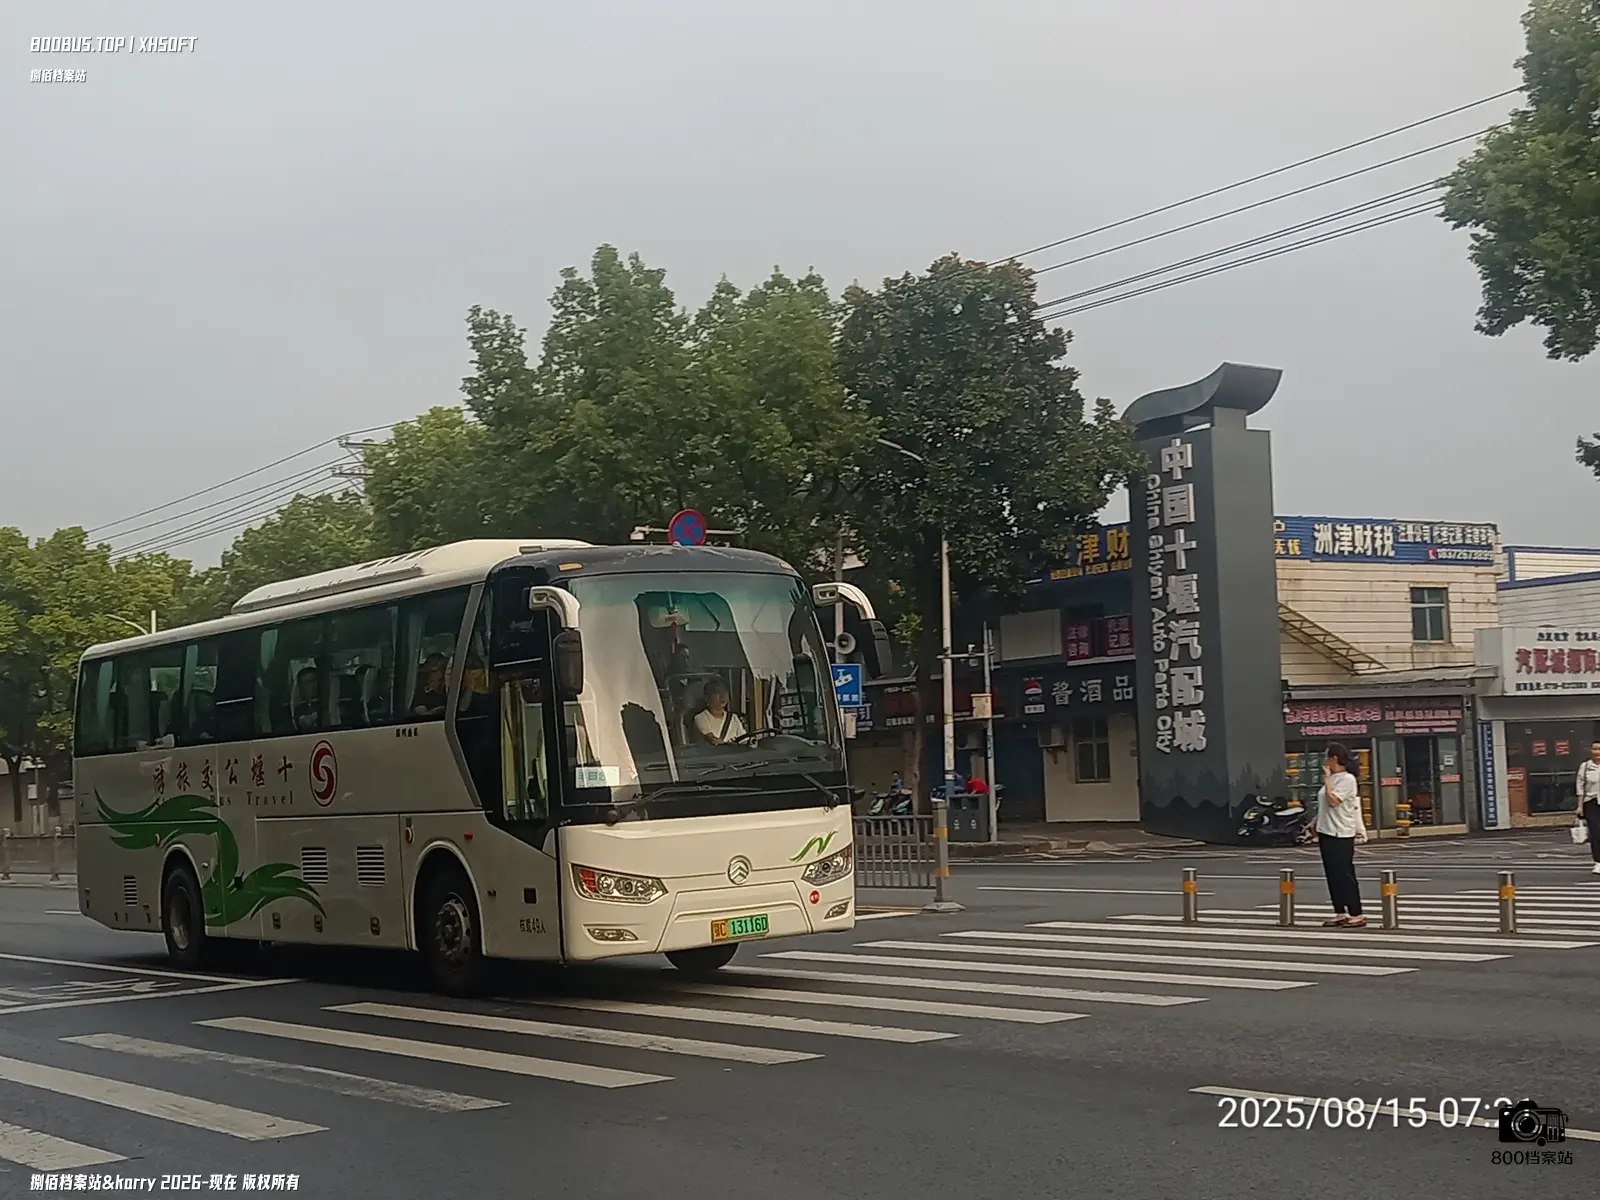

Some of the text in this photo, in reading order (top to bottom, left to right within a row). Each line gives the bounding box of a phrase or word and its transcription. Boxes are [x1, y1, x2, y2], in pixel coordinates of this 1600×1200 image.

[1313, 522, 1396, 557] 洲津财税
[1161, 438, 1207, 752] 中国十堰汽配城
[1151, 607, 1167, 653] Auto
[246, 790, 293, 806] Travel
